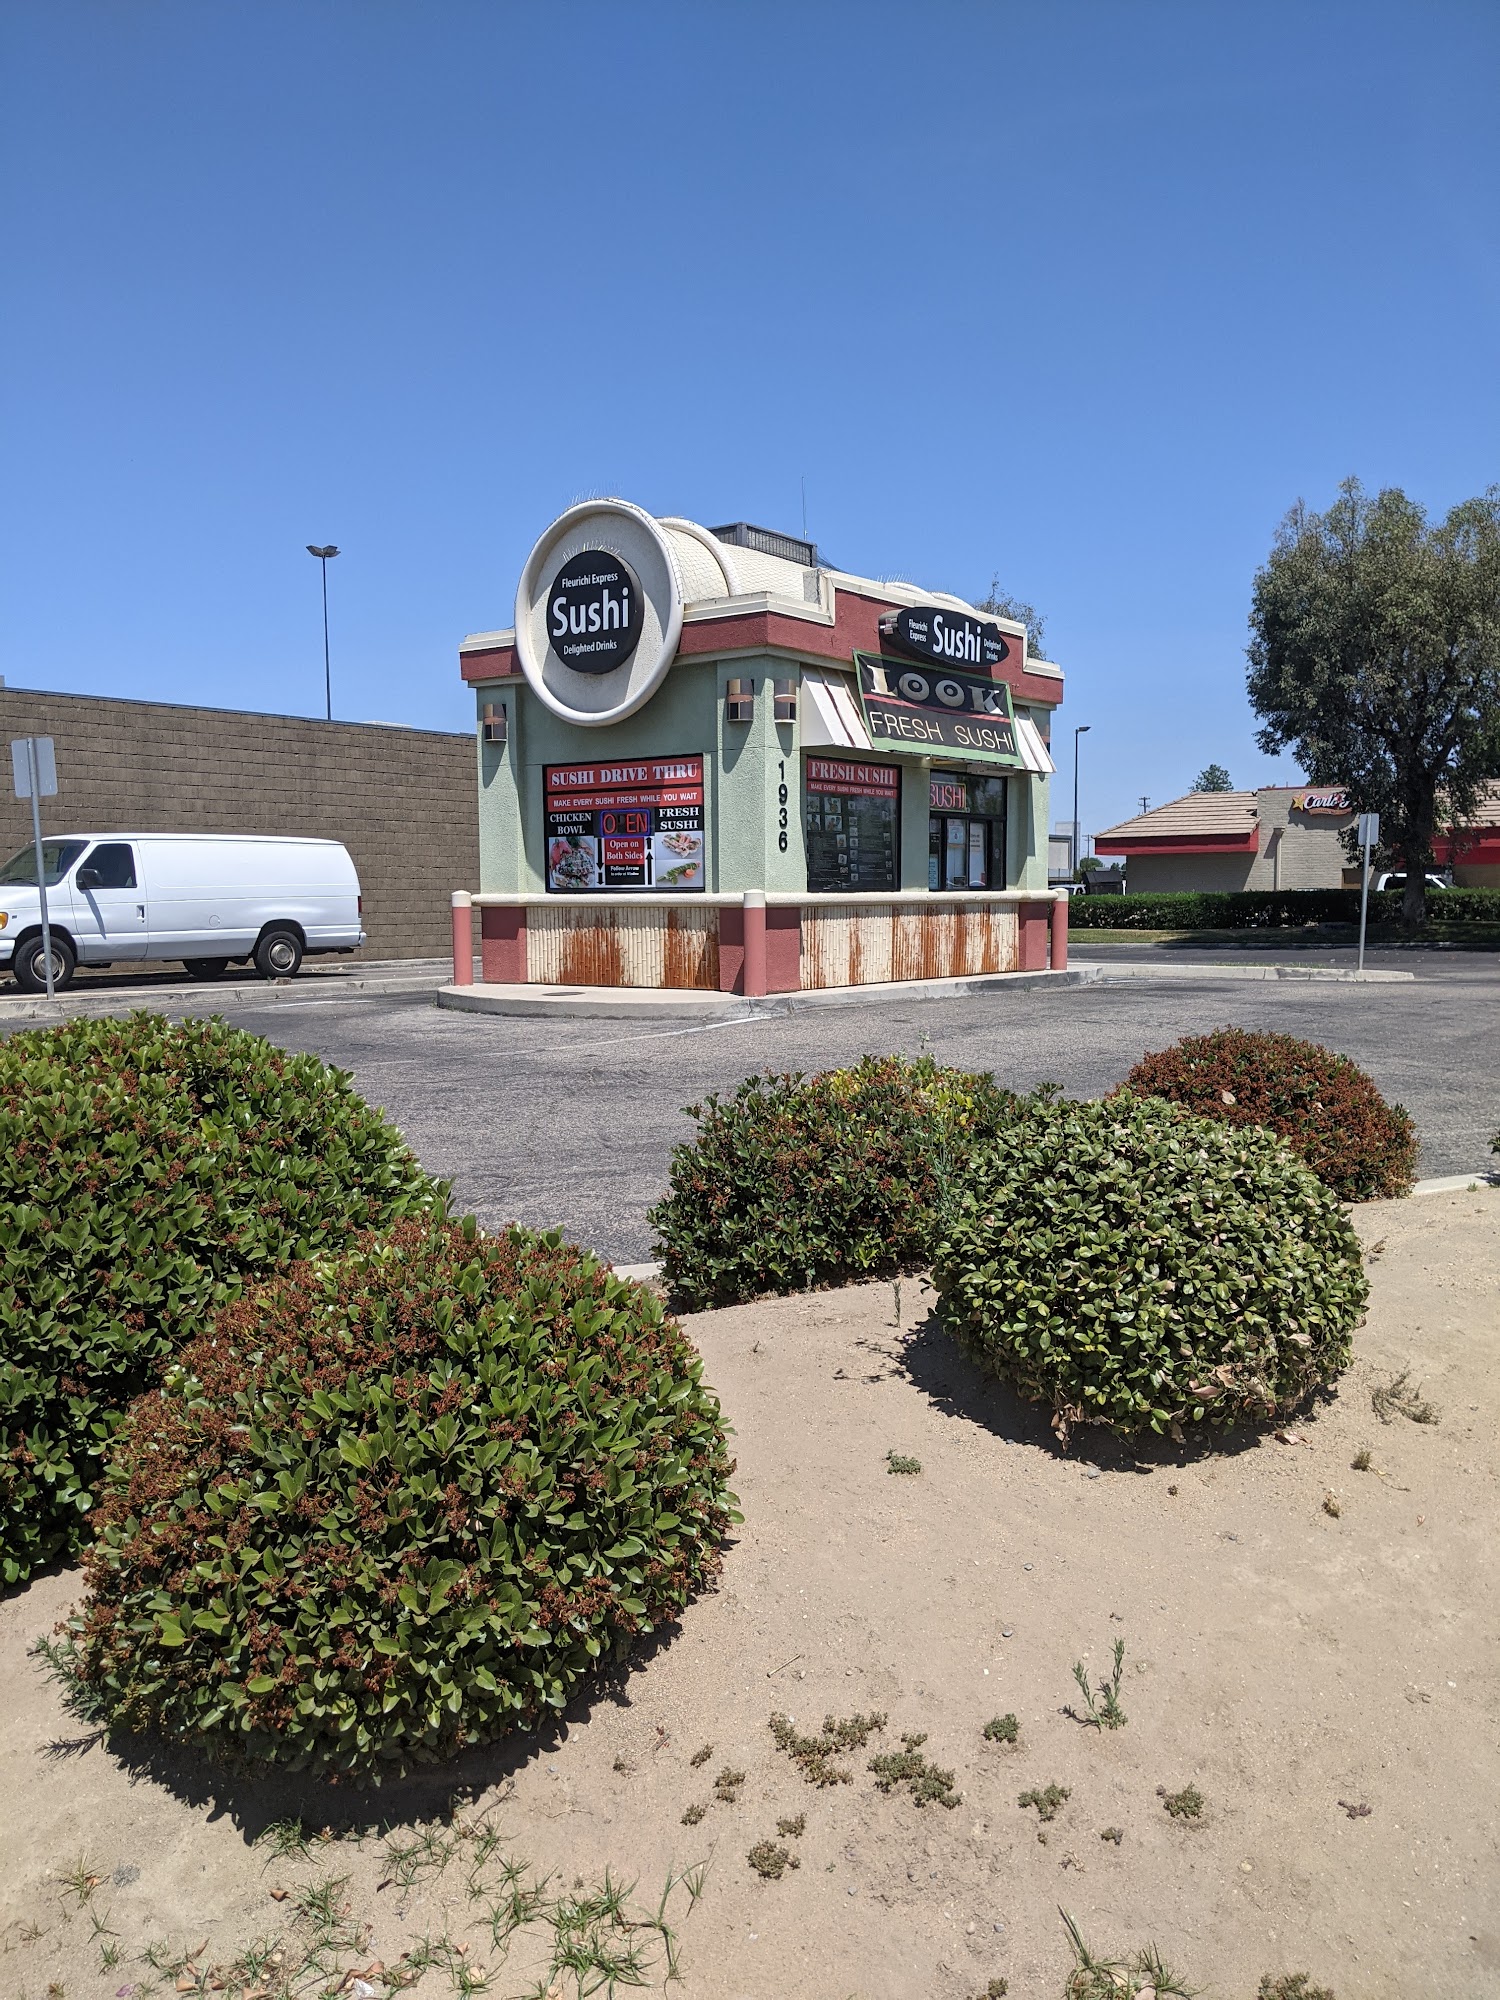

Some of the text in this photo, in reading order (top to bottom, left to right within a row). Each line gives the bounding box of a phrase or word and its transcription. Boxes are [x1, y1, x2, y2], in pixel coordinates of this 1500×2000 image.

[562, 572, 618, 588] Fleurichi Express
[553, 587, 629, 637] Sushi
[908, 619, 928, 633] Fleurichi
[909, 630, 927, 643] Express
[932, 614, 981, 663] Sushi
[563, 639, 618, 656] Delighted Drinks
[983, 638, 1002, 651] Delighted
[986, 651, 999, 662] Drinks
[866, 664, 1004, 716] LOOK
[869, 711, 1015, 752] FRESH SUSHI
[551, 763, 699, 786] SUSHI DRIVE THRU
[811, 761, 894, 785] FRESH SUSHI
[810, 783, 823, 791] MAKE
[823, 784, 836, 792] EVERY
[850, 786, 863, 794] FRESH
[863, 787, 875, 795] WHILE
[930, 784, 965, 809] SUSHI
[553, 792, 698, 807] MAKE EVERY SUSHI FRESH WHILE YOU WAIT
[778, 760, 789, 853] 1936
[550, 812, 592, 823] CHICKEN
[659, 807, 699, 818] FRESH
[557, 825, 586, 835] BOWL
[603, 813, 648, 834] OEN
[660, 820, 698, 830] SUSHI
[610, 840, 629, 850] Open
[606, 851, 643, 860] Both Sides
